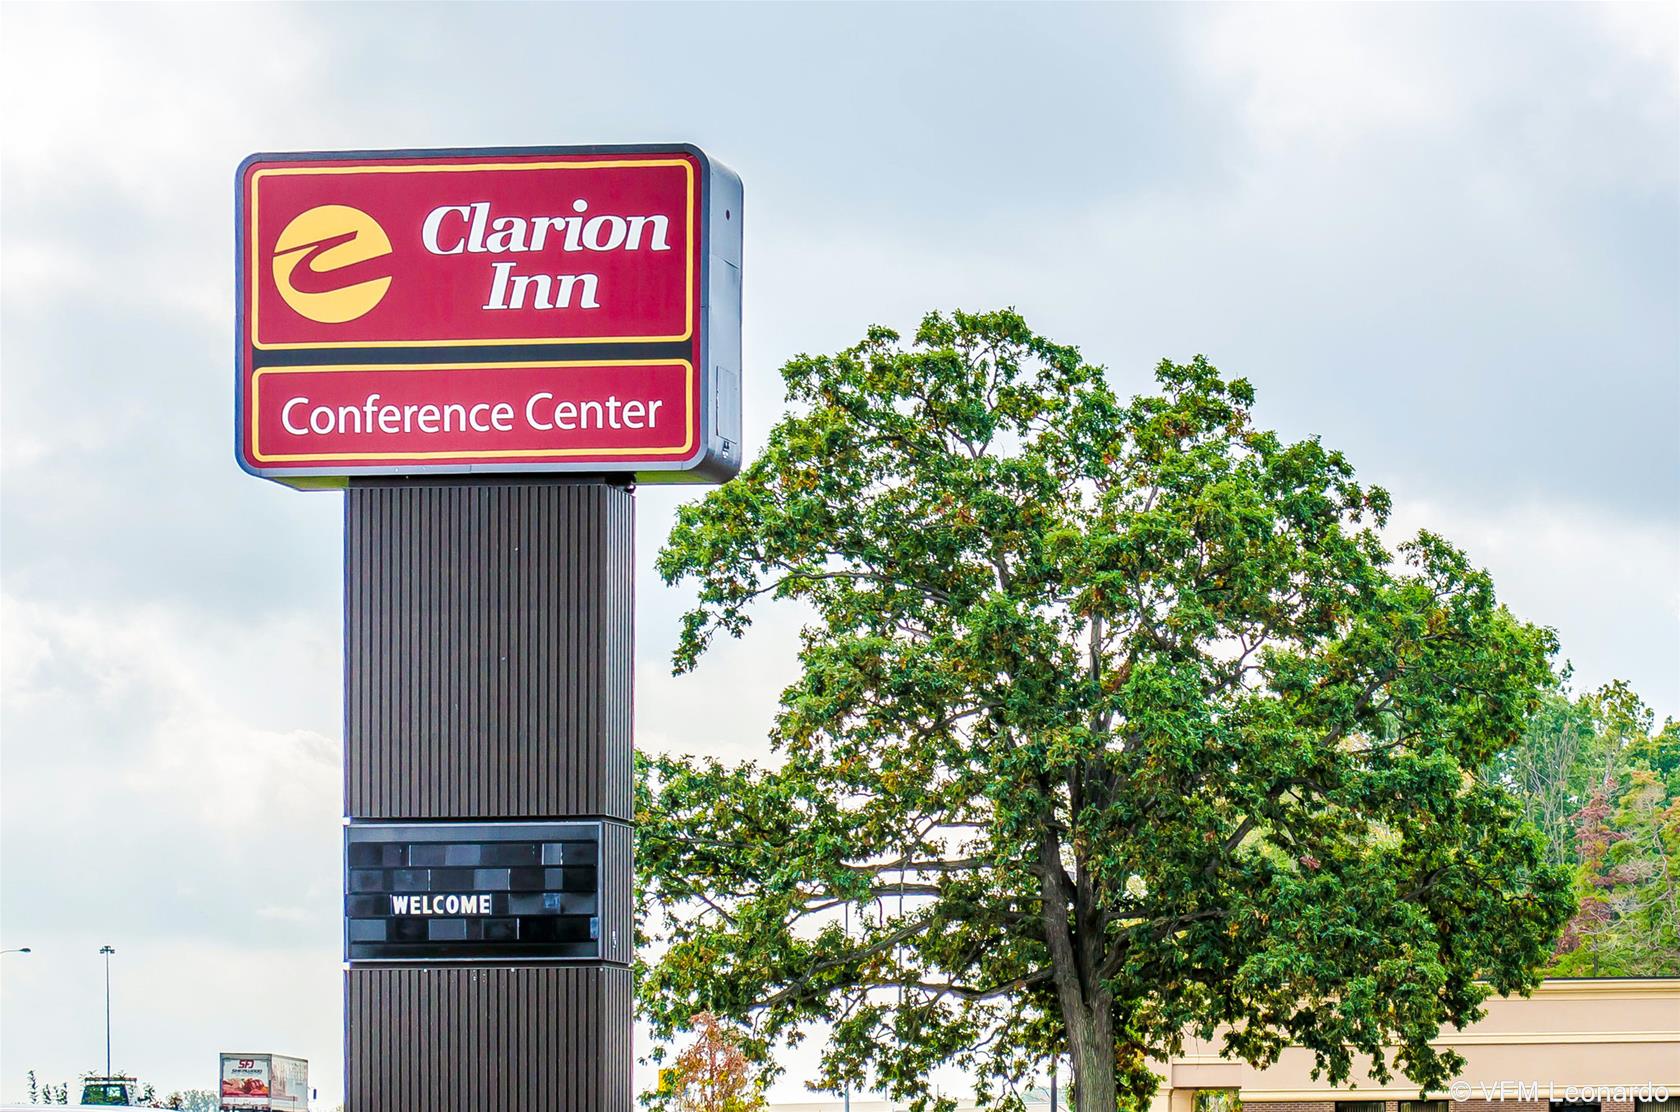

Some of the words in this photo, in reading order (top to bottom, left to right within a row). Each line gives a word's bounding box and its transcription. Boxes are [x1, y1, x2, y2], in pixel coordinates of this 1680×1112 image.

[422, 199, 671, 255] Clarion
[482, 262, 600, 310] Inn
[281, 393, 515, 435] Conference
[525, 392, 663, 431] Center
[392, 894, 490, 915] WELCOME
